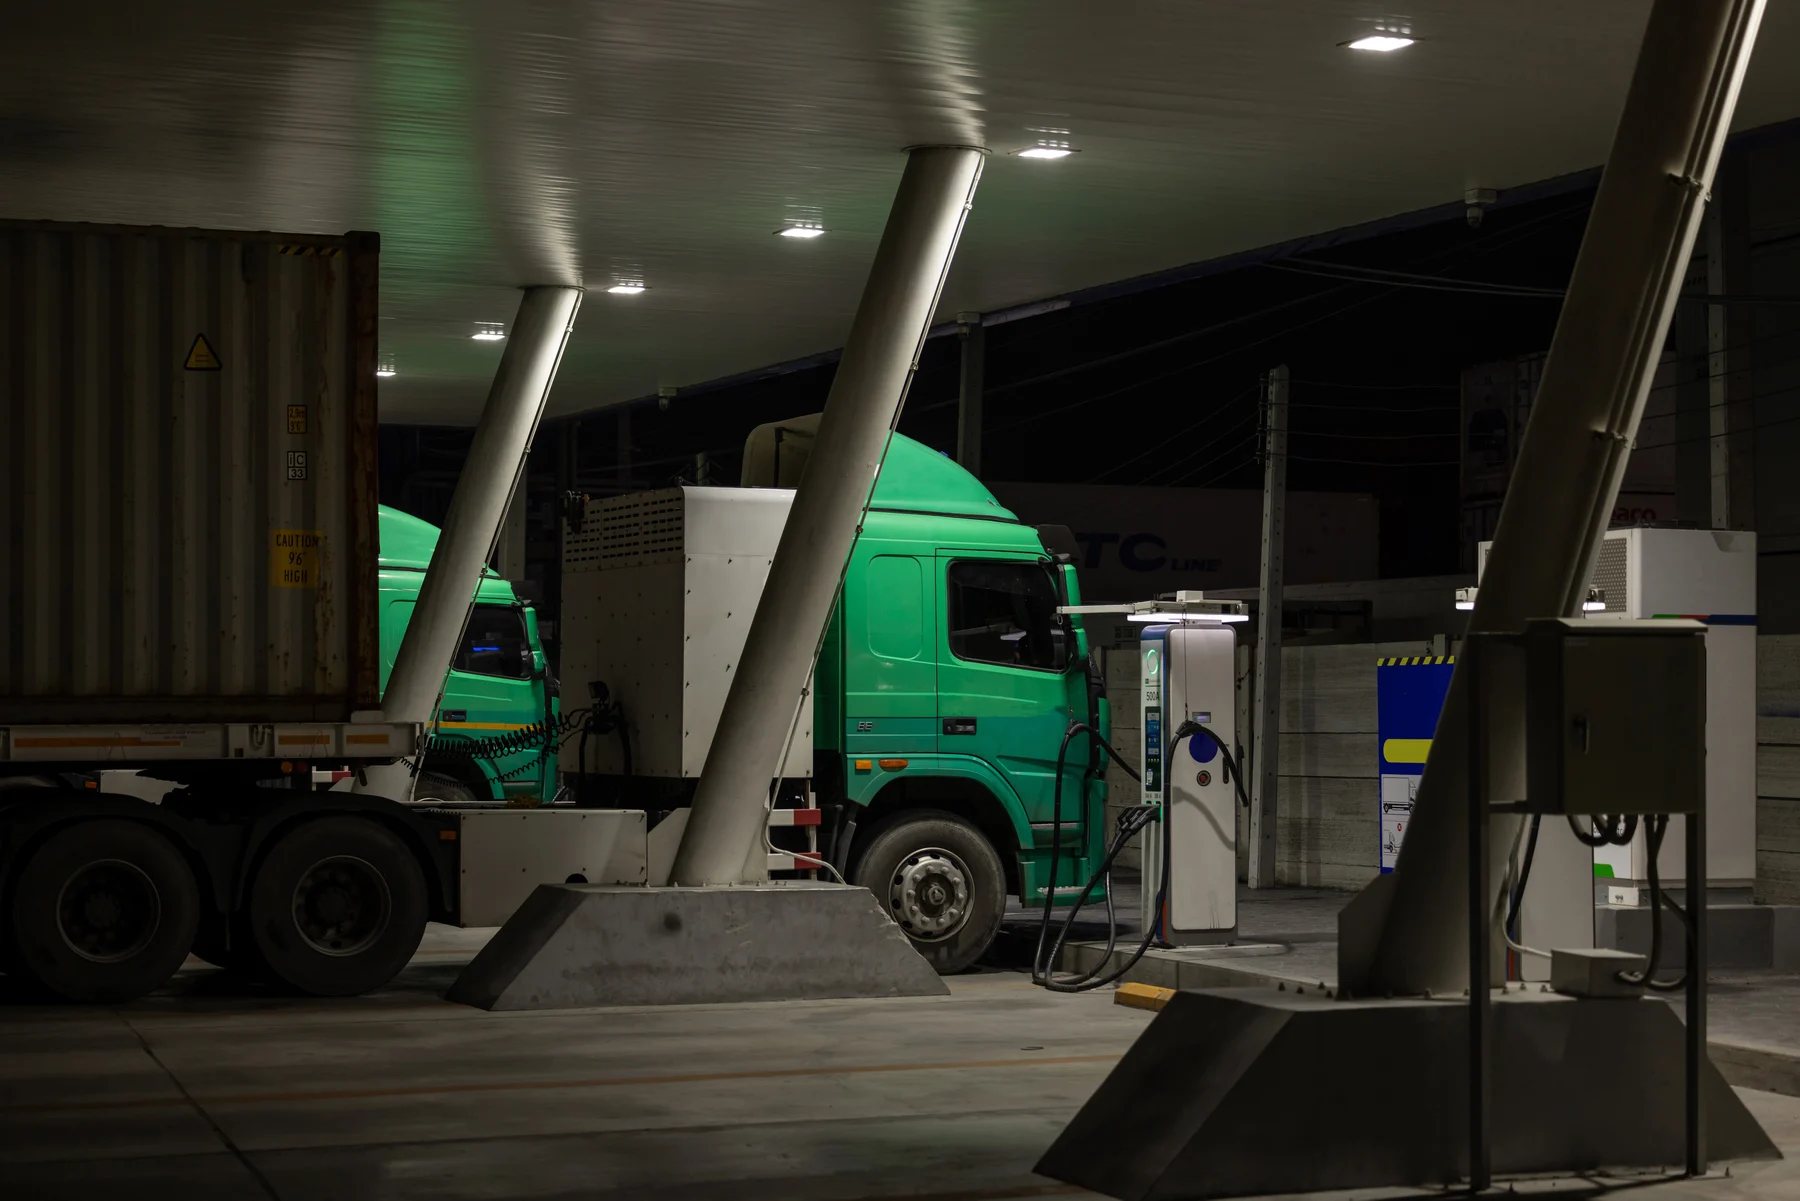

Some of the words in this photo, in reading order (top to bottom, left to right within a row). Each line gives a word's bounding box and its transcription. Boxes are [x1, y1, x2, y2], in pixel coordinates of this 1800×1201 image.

[291, 468, 303, 478] 33
[276, 533, 319, 548] CAUTION
[1170, 558, 1222, 572] LINE
[284, 569, 308, 584] HIGH
[1146, 691, 1161, 701] 500A
